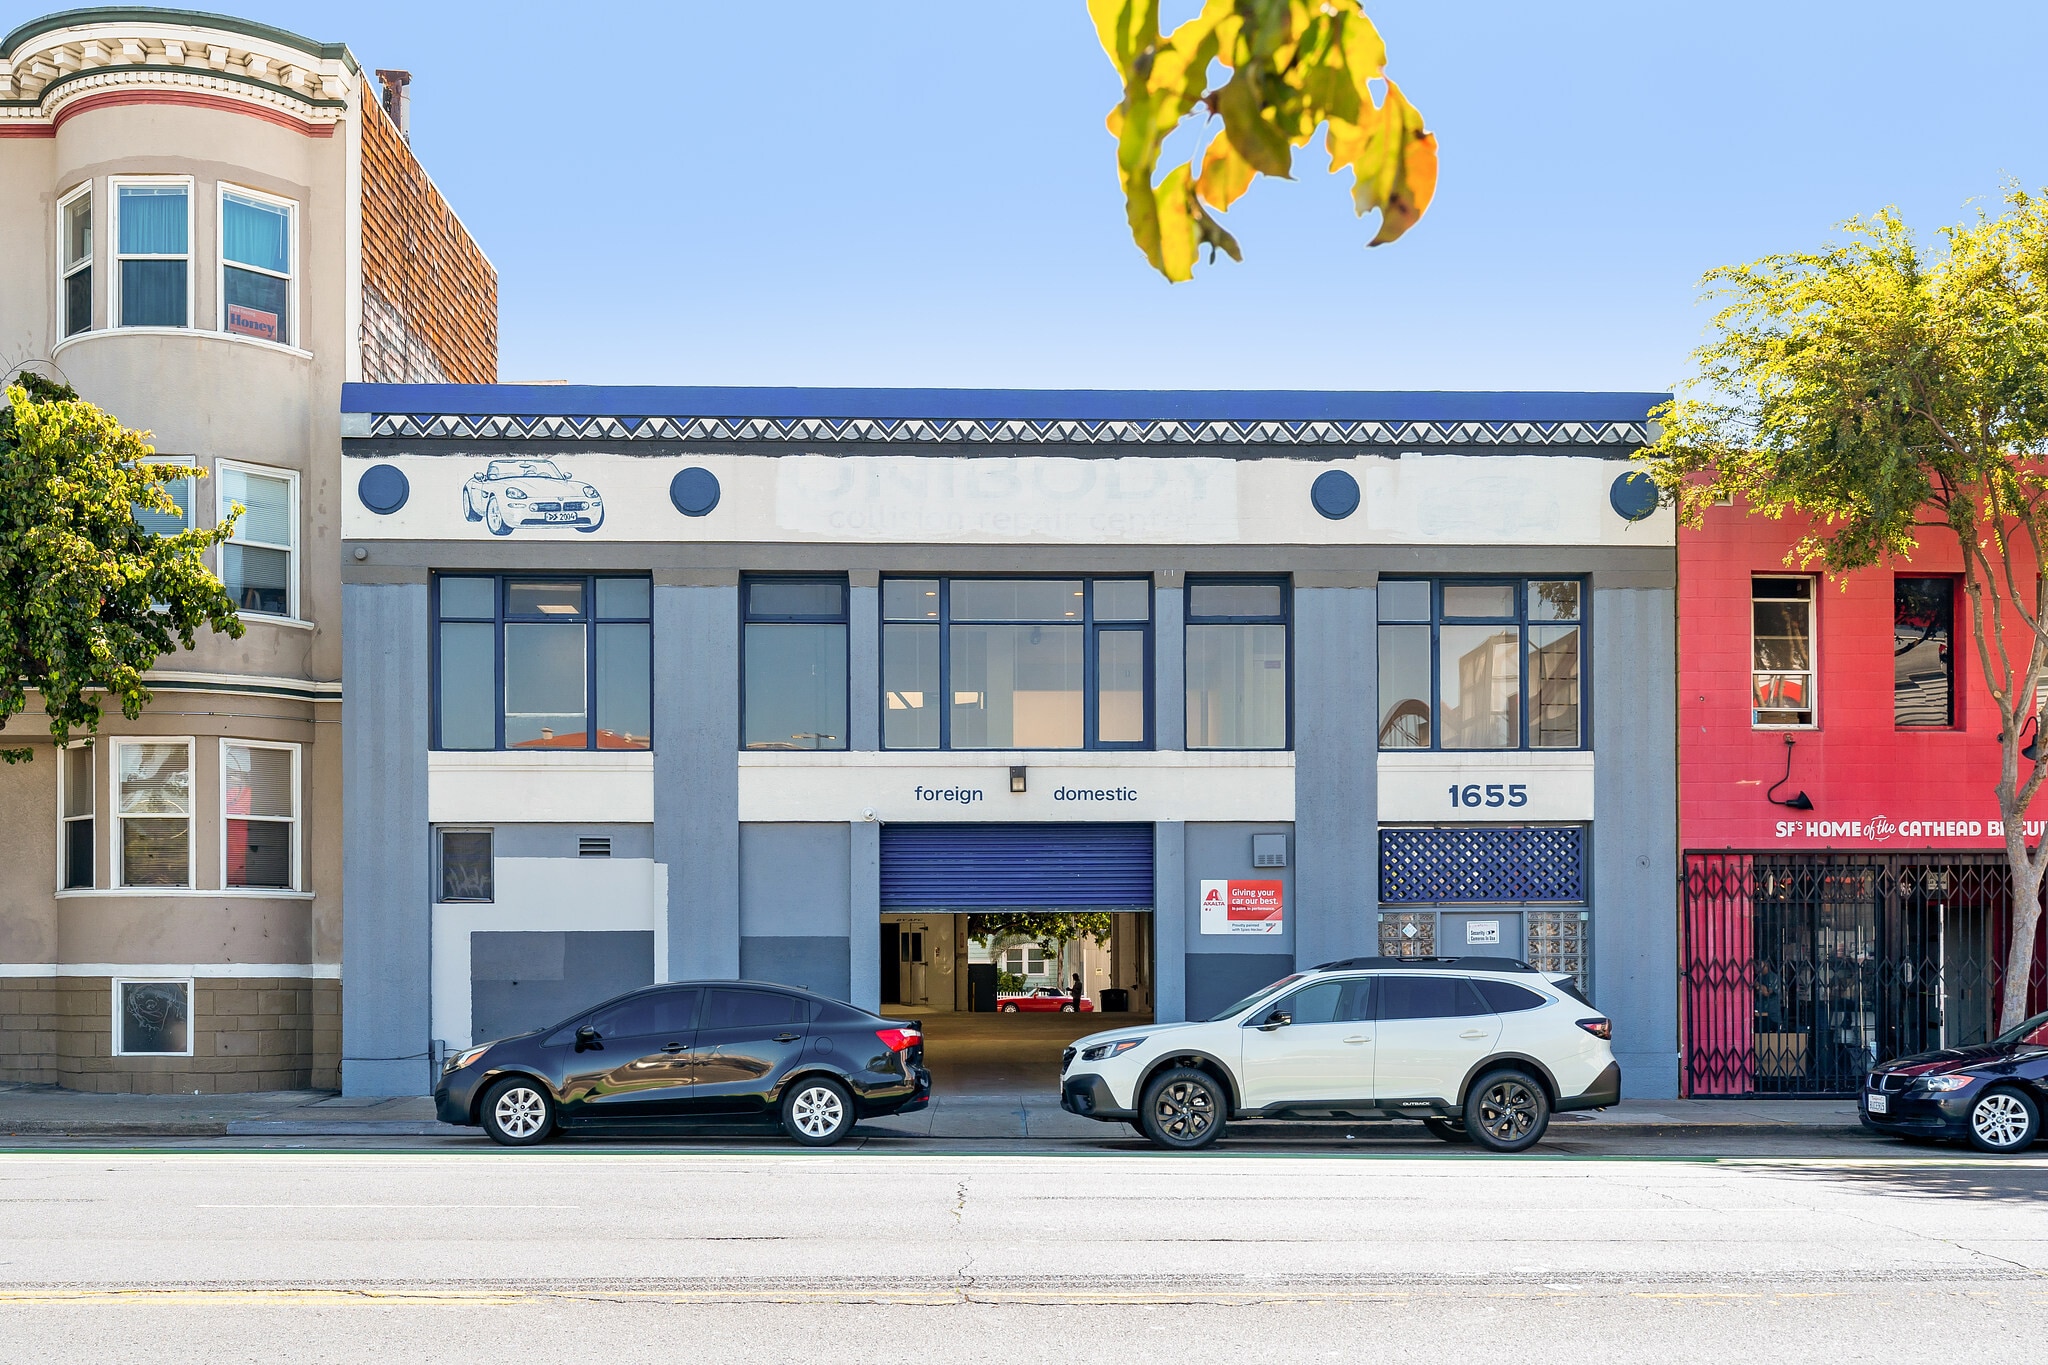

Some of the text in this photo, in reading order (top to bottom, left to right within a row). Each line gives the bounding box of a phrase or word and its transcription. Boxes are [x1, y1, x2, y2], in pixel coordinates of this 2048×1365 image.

[231, 313, 274, 337] Honey
[828, 505, 964, 530] collision
[979, 505, 1084, 536] repair
[914, 785, 1138, 805] foreign domestic
[1448, 784, 1528, 808] 1655
[1806, 821, 1862, 837] HOME
[1863, 820, 1876, 841] of
[1876, 819, 1897, 834] the
[1898, 820, 1982, 837] CATHEAD
[1231, 888, 1275, 898] Giving your
[1259, 897, 1279, 905] best.
